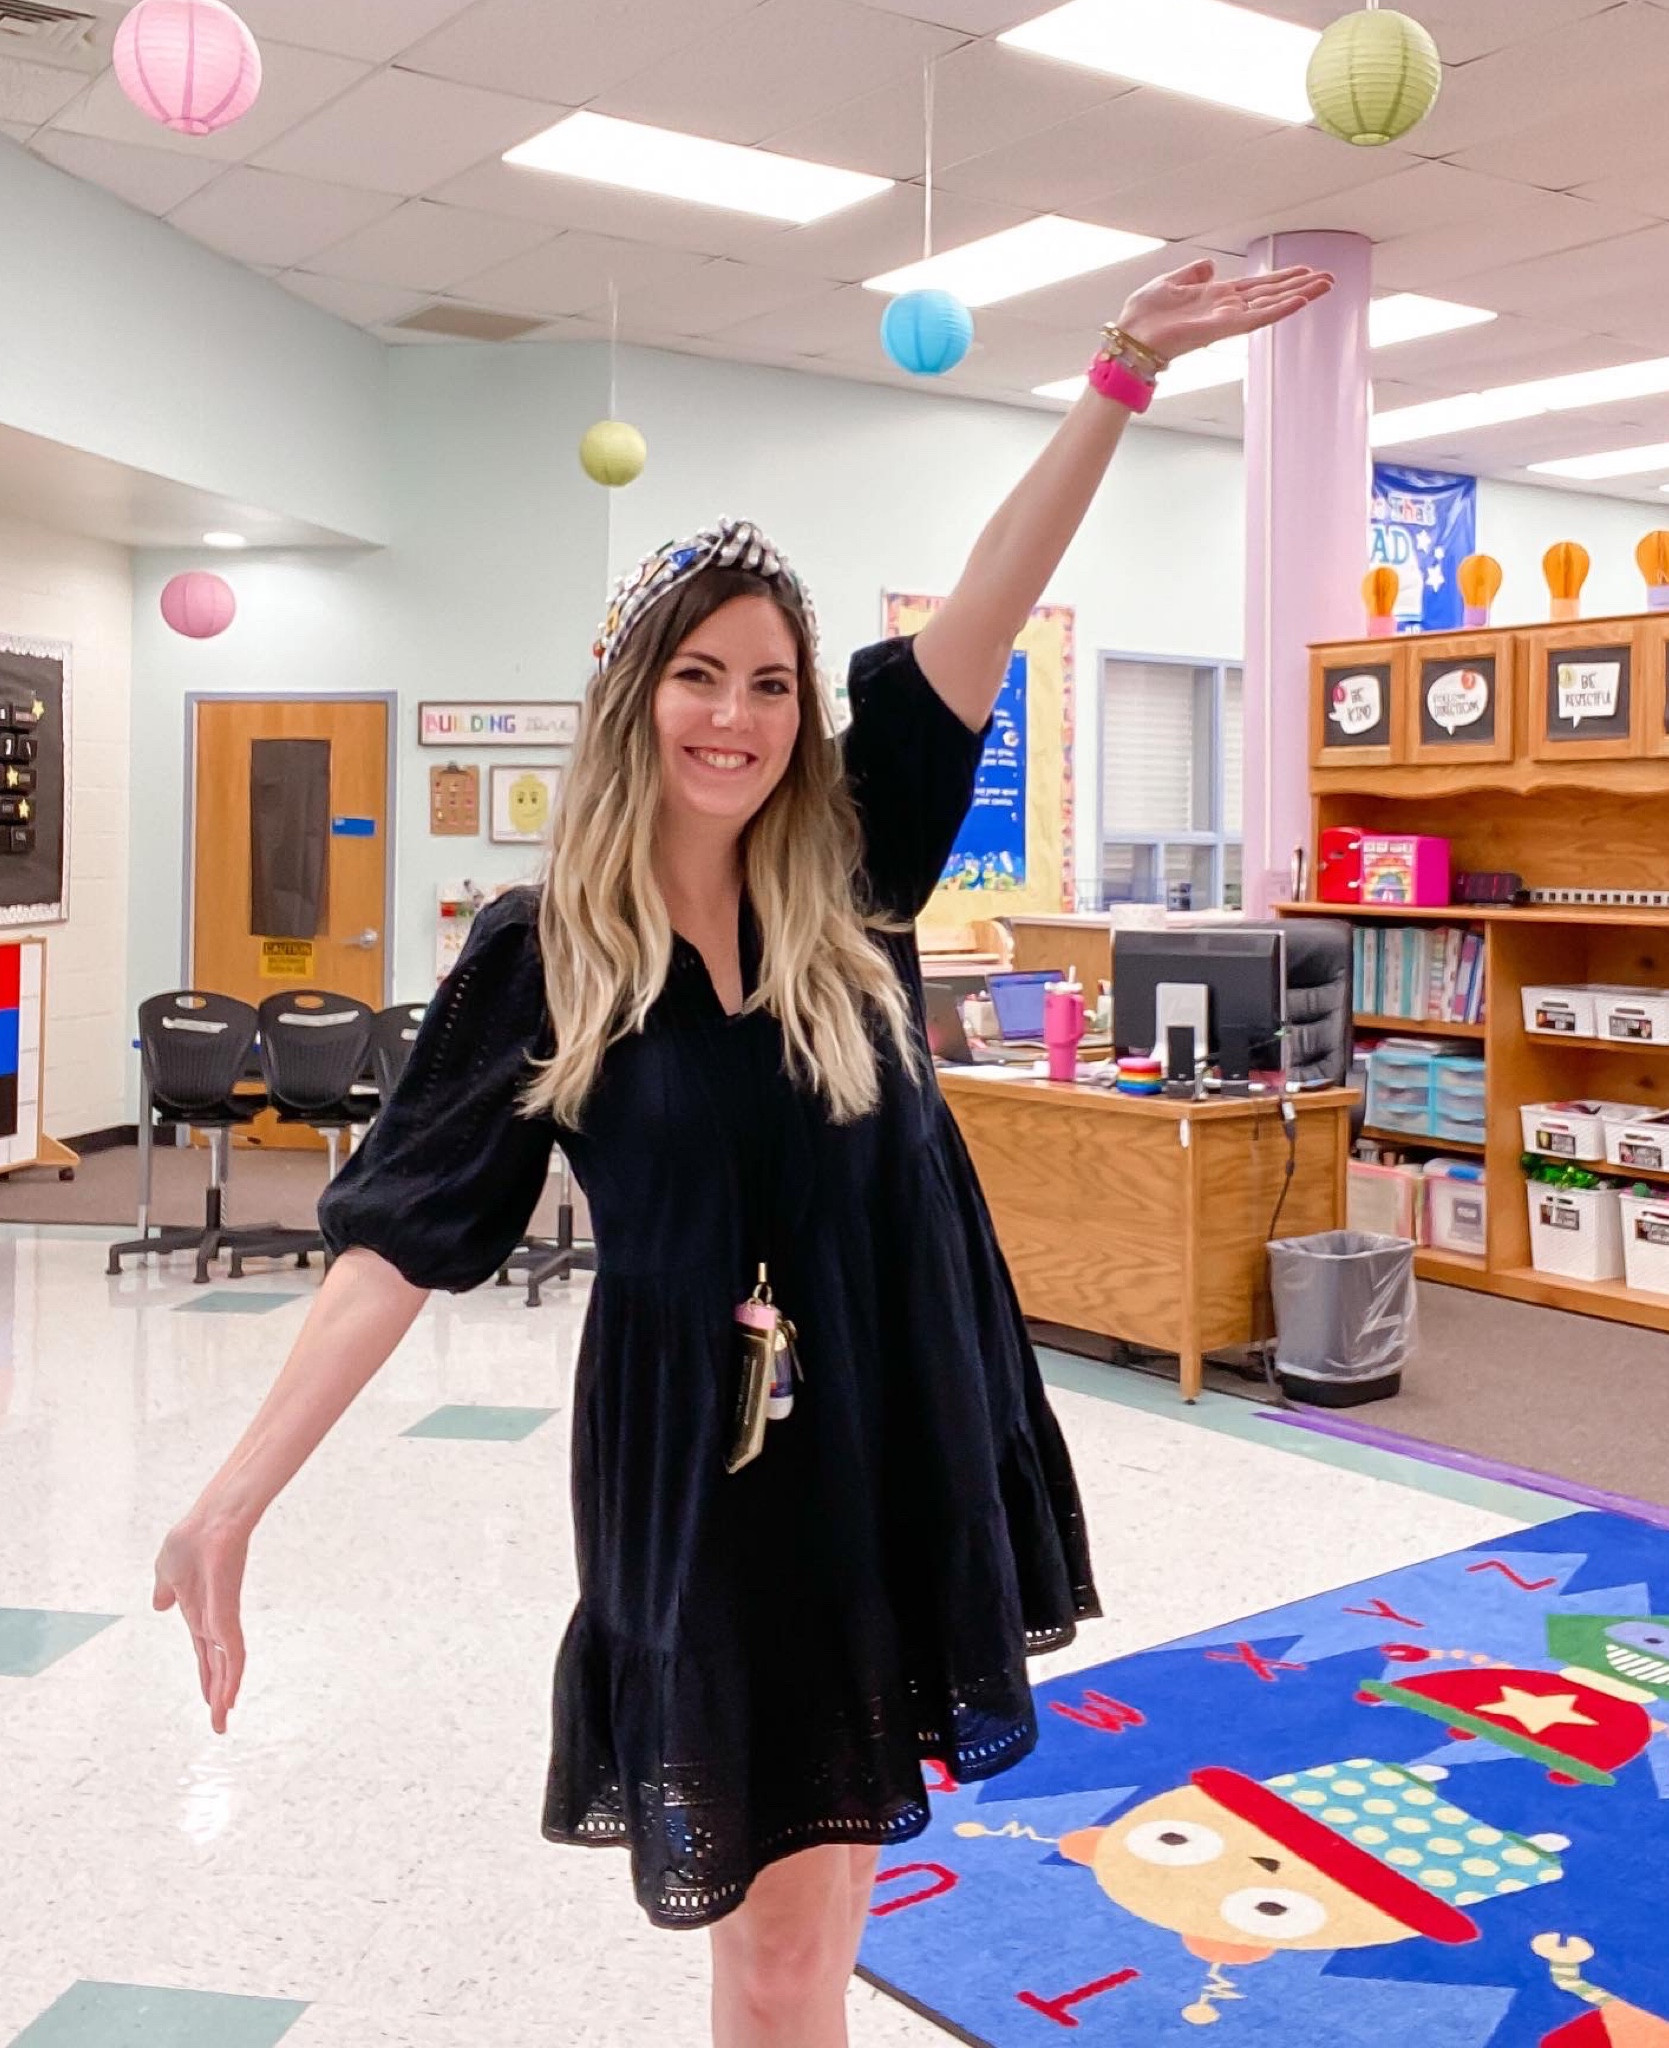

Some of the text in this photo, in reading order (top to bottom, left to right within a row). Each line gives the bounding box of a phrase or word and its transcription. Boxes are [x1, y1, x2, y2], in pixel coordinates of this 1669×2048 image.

[1581, 672, 1596, 690] BE
[424, 714, 516, 733] BUILDING
[1347, 705, 1371, 723] KIND
[1465, 1559, 1558, 1592] Z
[1342, 1598, 1426, 1628] Y
[1204, 1641, 1307, 1682] X
[1049, 1690, 1147, 1733] W
[868, 1861, 960, 1917] U
[1015, 1968, 1142, 2028] T
